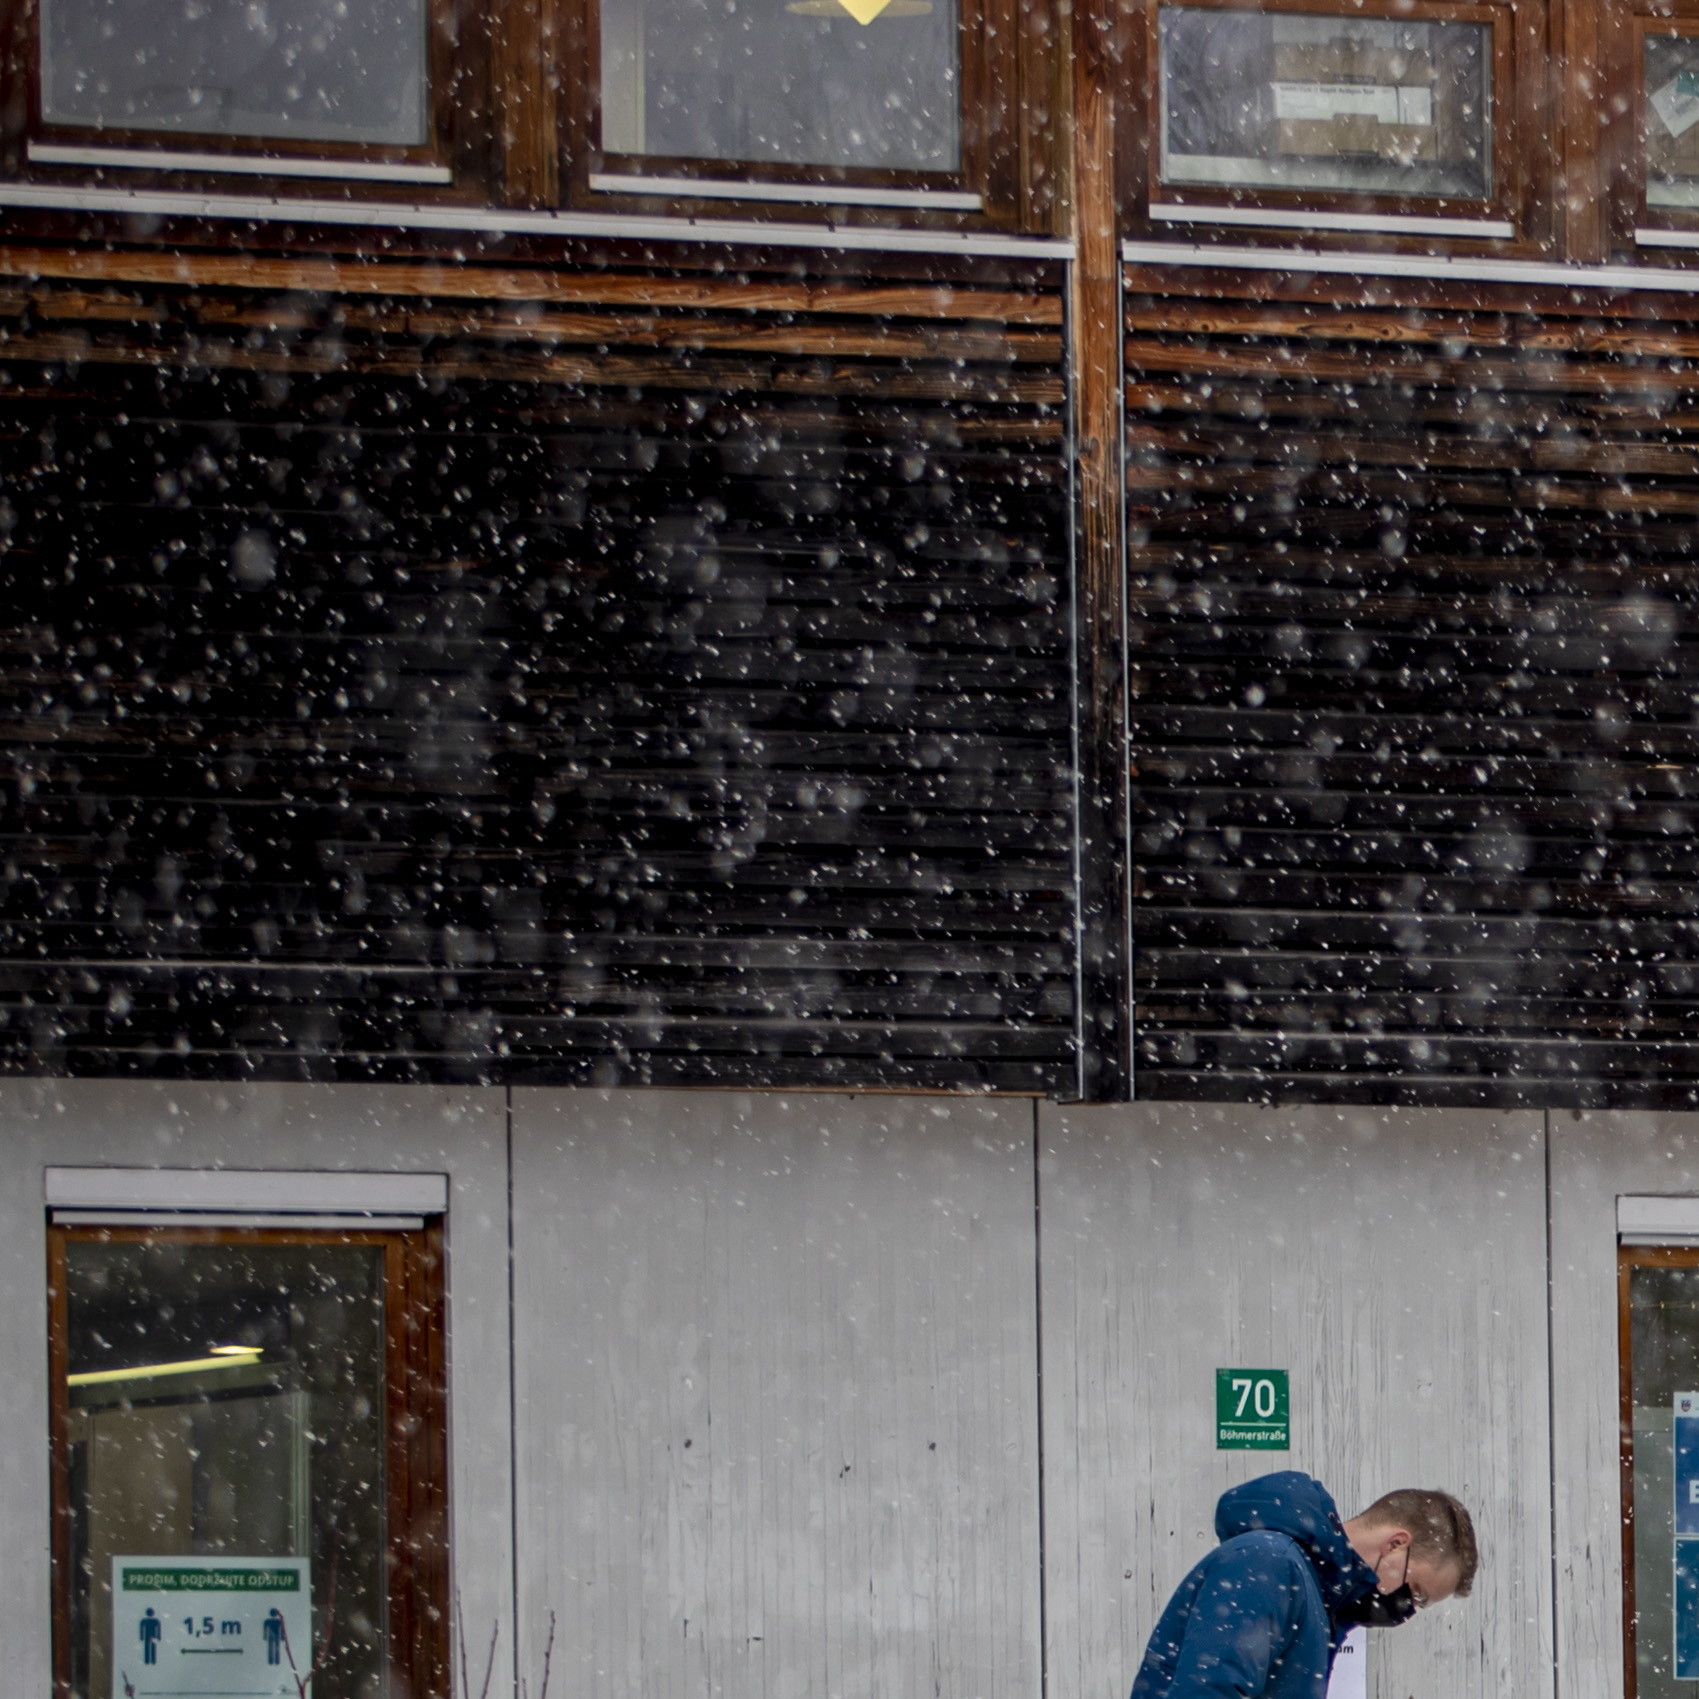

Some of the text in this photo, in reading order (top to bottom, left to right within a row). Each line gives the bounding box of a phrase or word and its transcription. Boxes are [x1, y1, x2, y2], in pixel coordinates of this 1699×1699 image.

[1232, 1379, 1275, 1417] 70
[1220, 1428, 1286, 1441] Böhmerstraße
[184, 1616, 242, 1637] 1,5 m
